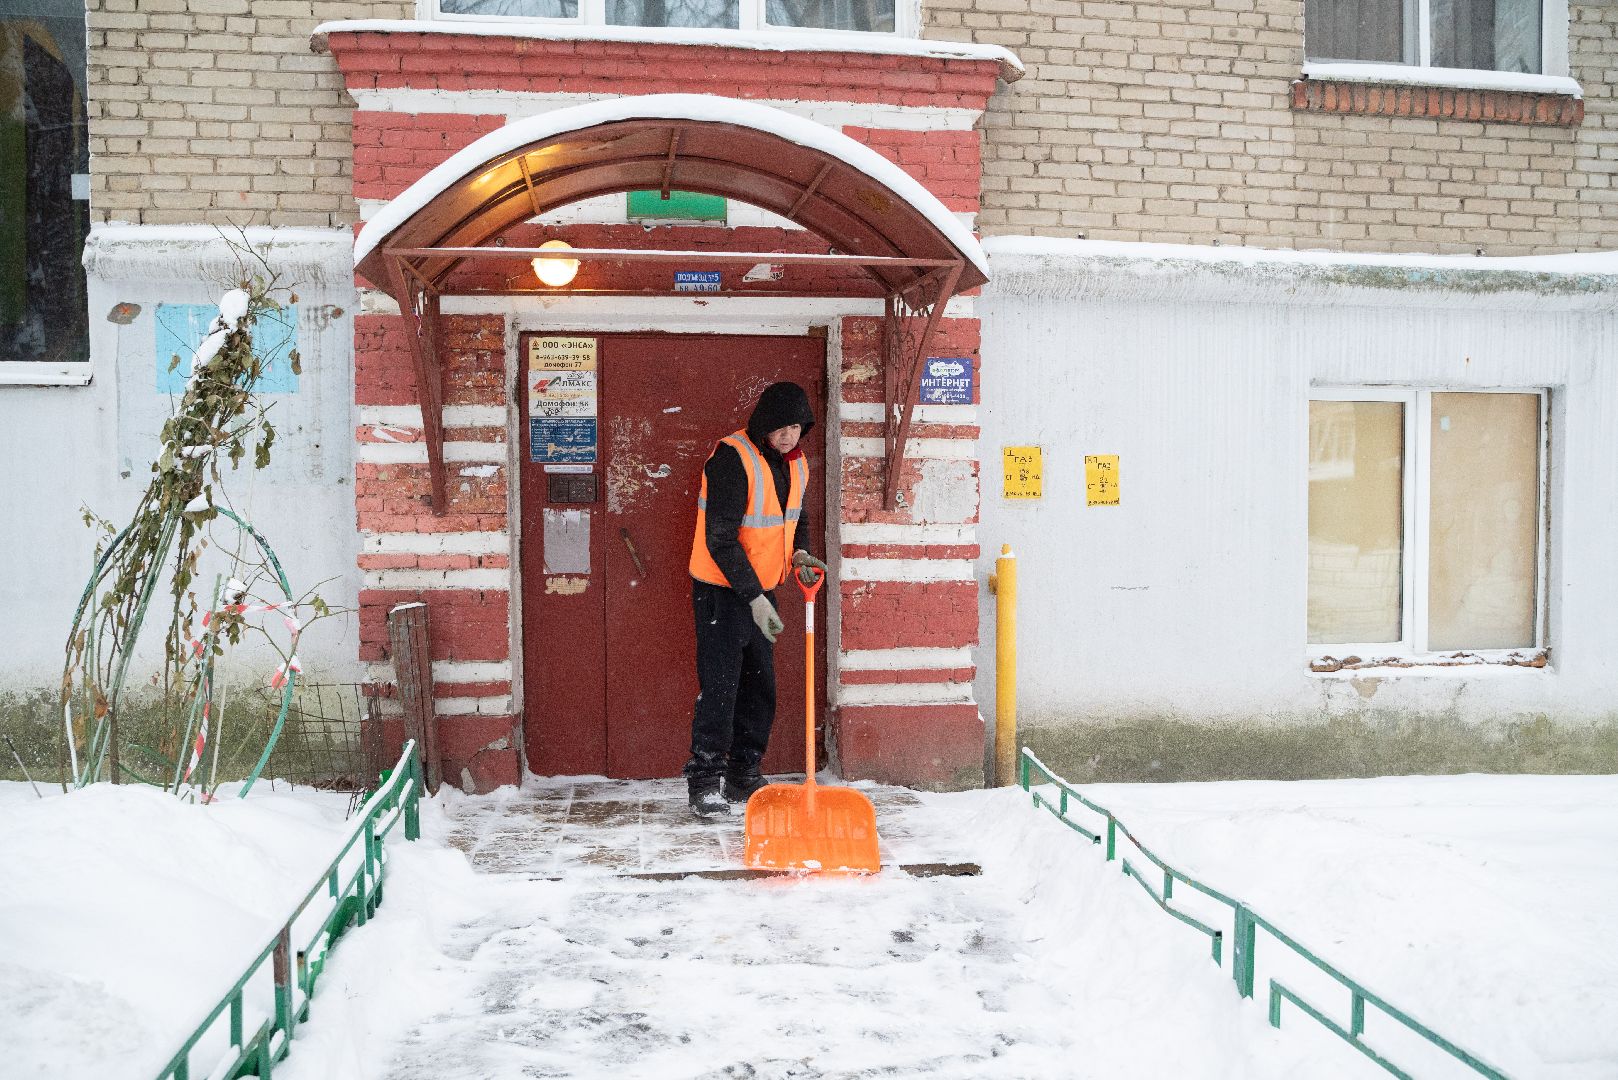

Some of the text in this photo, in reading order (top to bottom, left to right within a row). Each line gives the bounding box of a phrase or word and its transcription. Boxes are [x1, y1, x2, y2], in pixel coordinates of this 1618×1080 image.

[542, 341, 594, 349] ООО «ЭНСА»
[921, 378, 971, 388] ИНТЕРНЕТ
[1014, 455, 1033, 463] ГАЗ
[1097, 462, 1112, 471] ГАЗ
